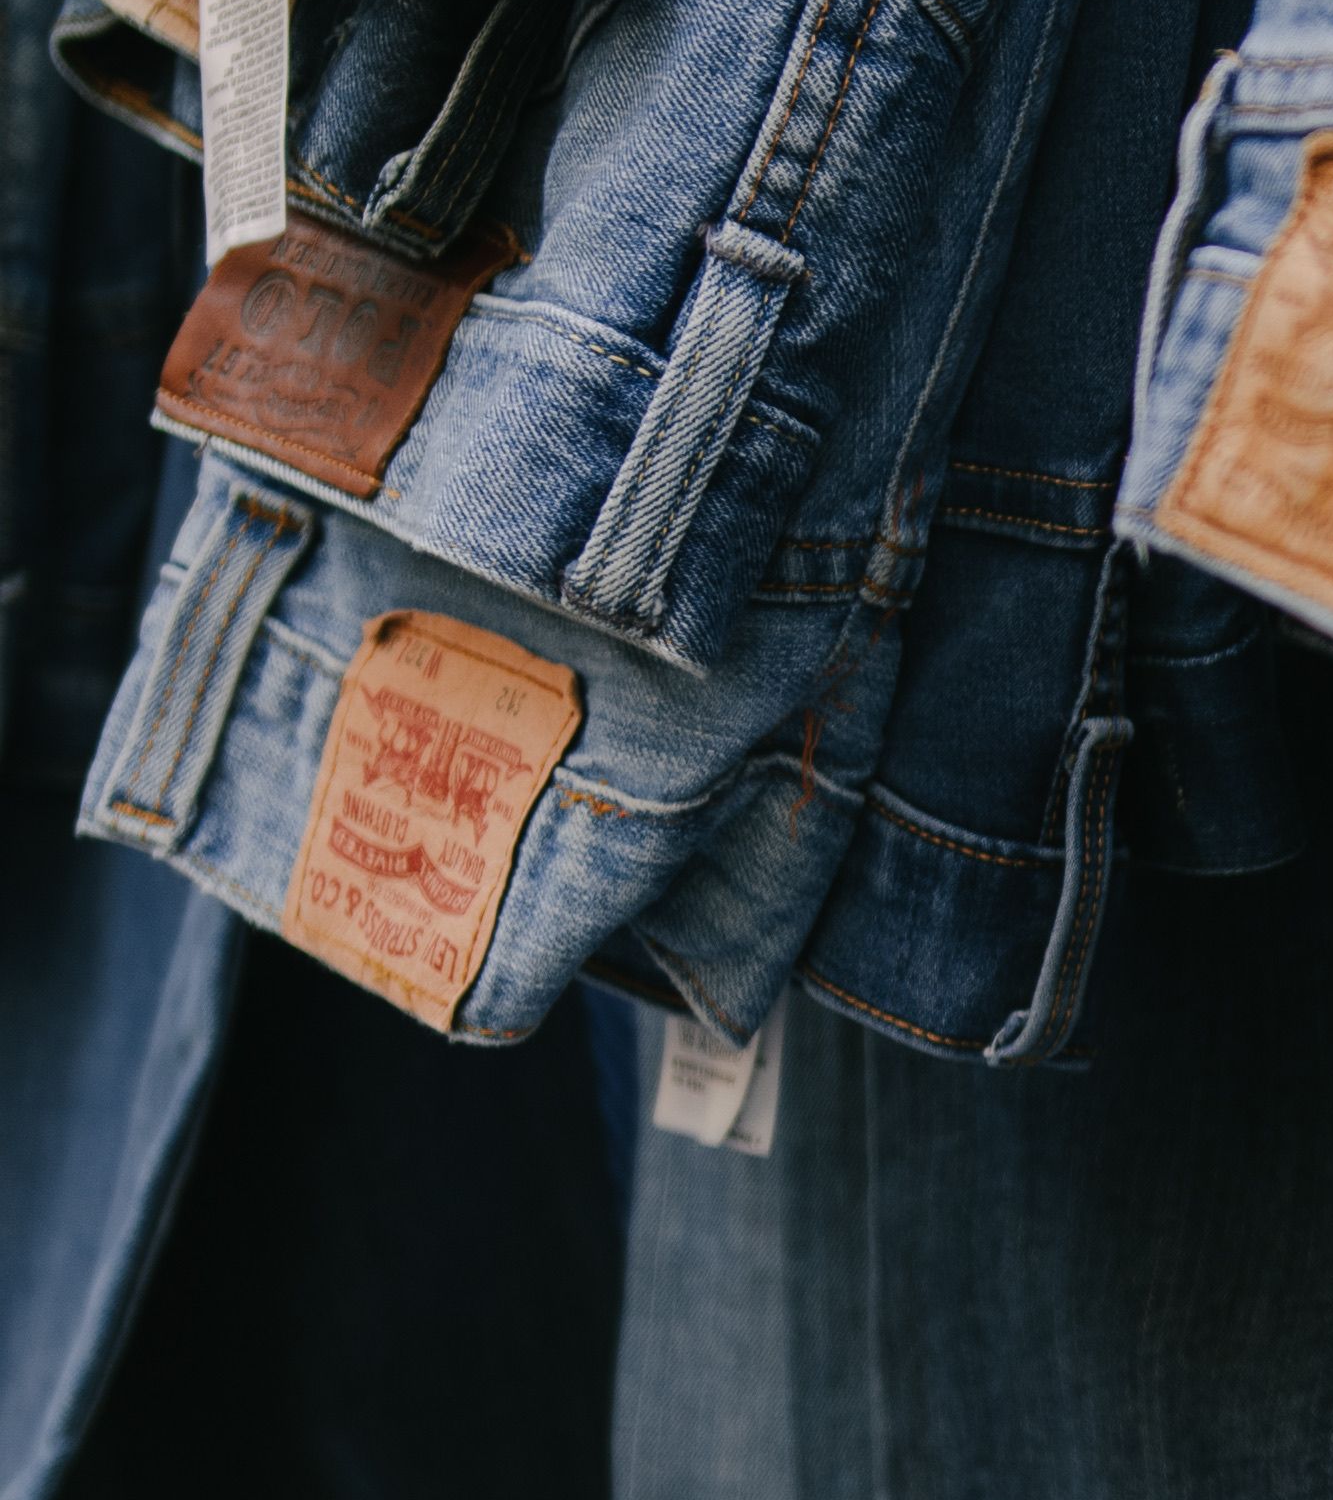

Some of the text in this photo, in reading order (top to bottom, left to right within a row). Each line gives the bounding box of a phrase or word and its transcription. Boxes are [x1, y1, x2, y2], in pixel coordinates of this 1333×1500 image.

[240, 269, 422, 391] POLO
[343, 789, 485, 885] QUALITY CLOTHING
[308, 867, 458, 983] LEVI STRAUSS & CO.
